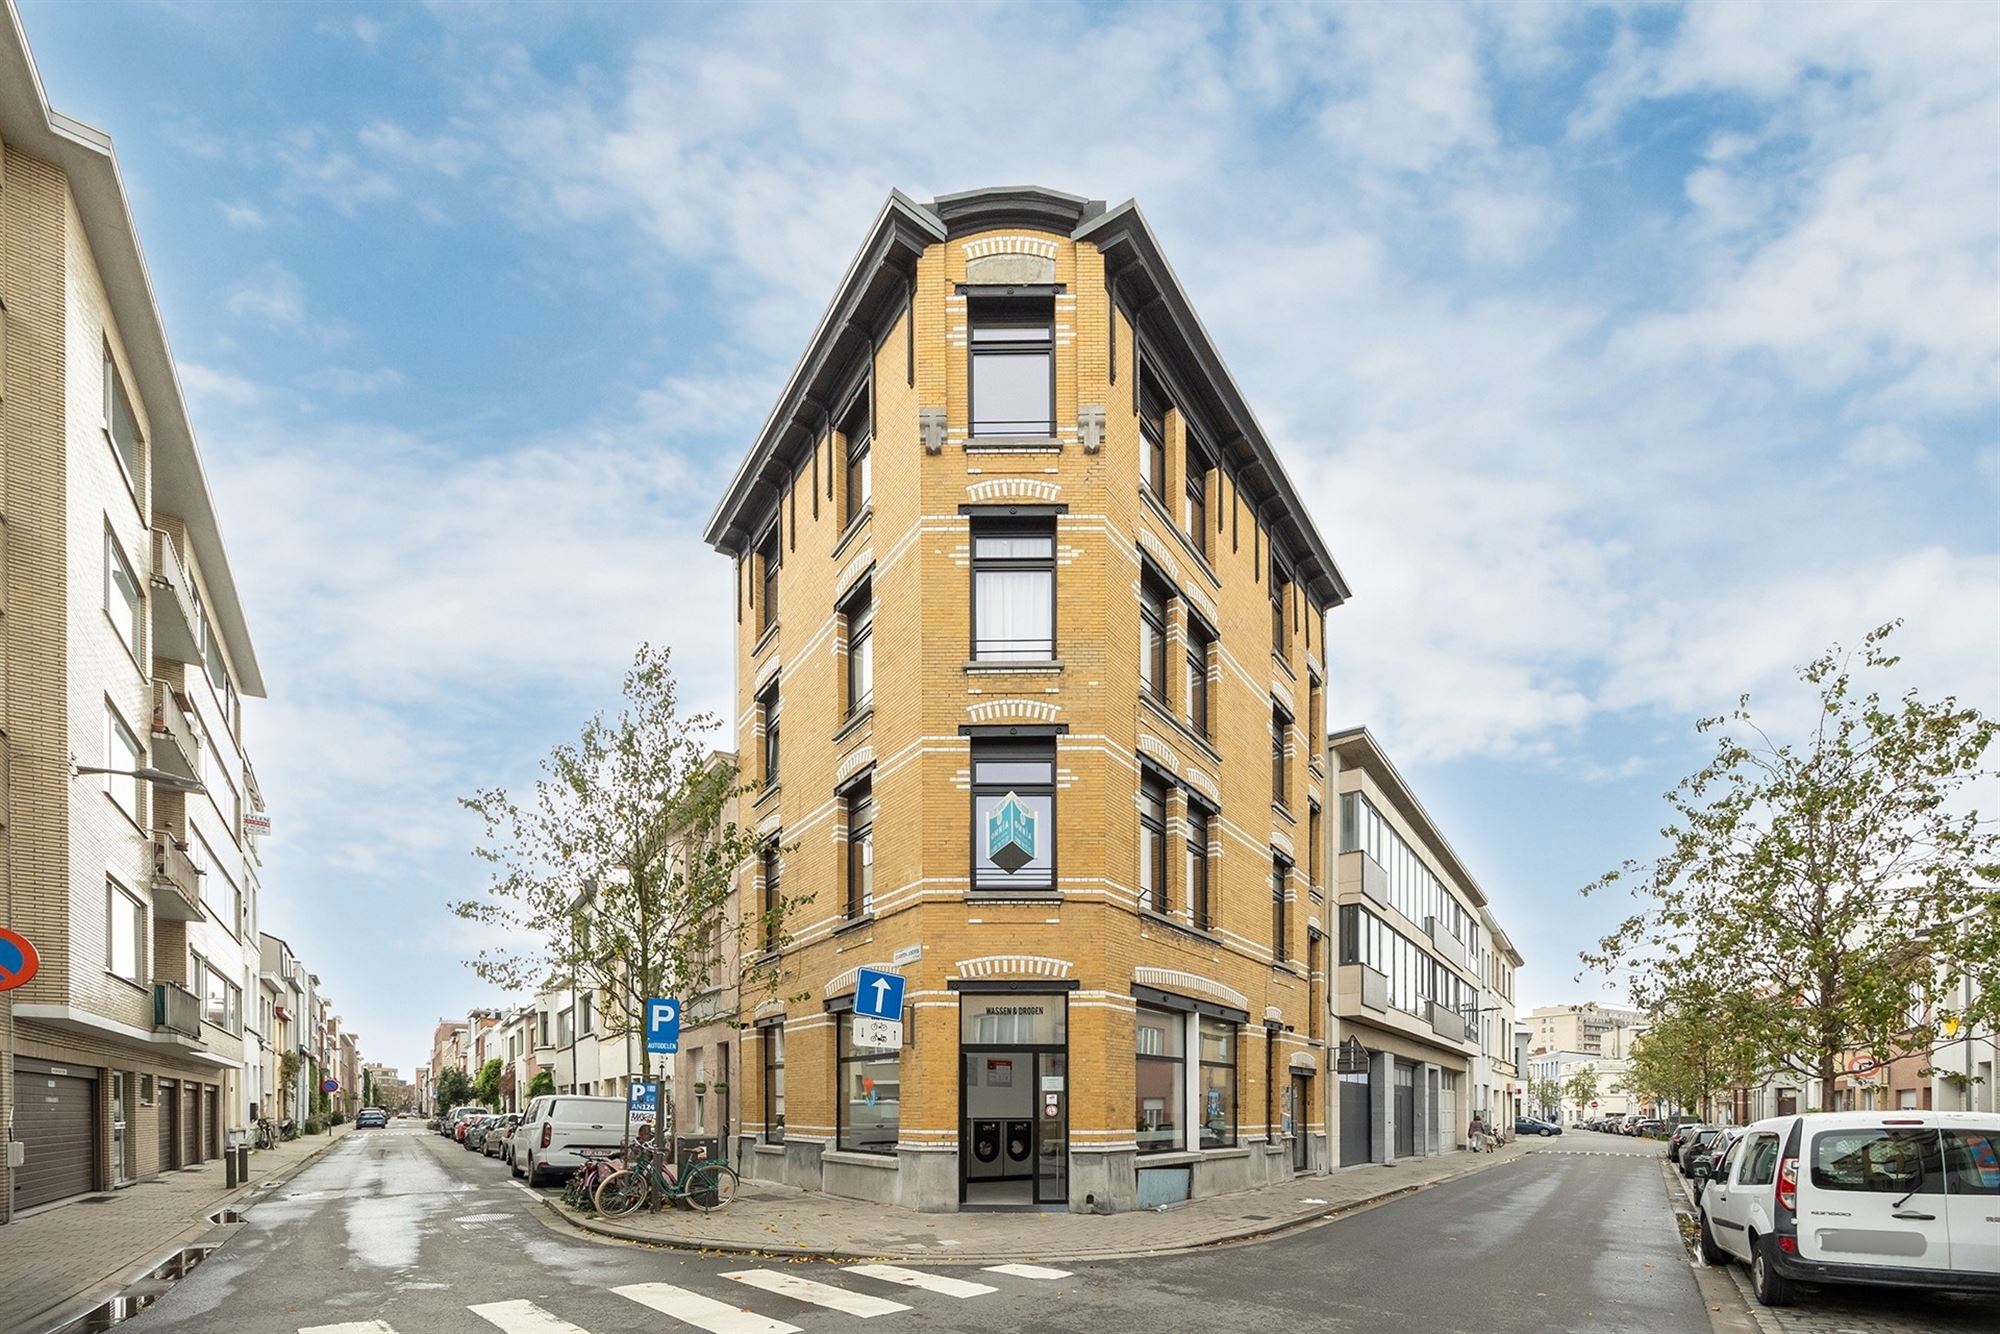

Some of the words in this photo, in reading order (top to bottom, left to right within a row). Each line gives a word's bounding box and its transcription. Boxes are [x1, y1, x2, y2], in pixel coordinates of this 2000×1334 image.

[985, 1007, 1012, 1015] WASSEN
[1013, 1007, 1017, 1015] &
[1018, 1007, 1044, 1015] DROGEN
[652, 1005, 675, 1032] P
[648, 1042, 676, 1050] AUTODELEN
[631, 1084, 646, 1101] P
